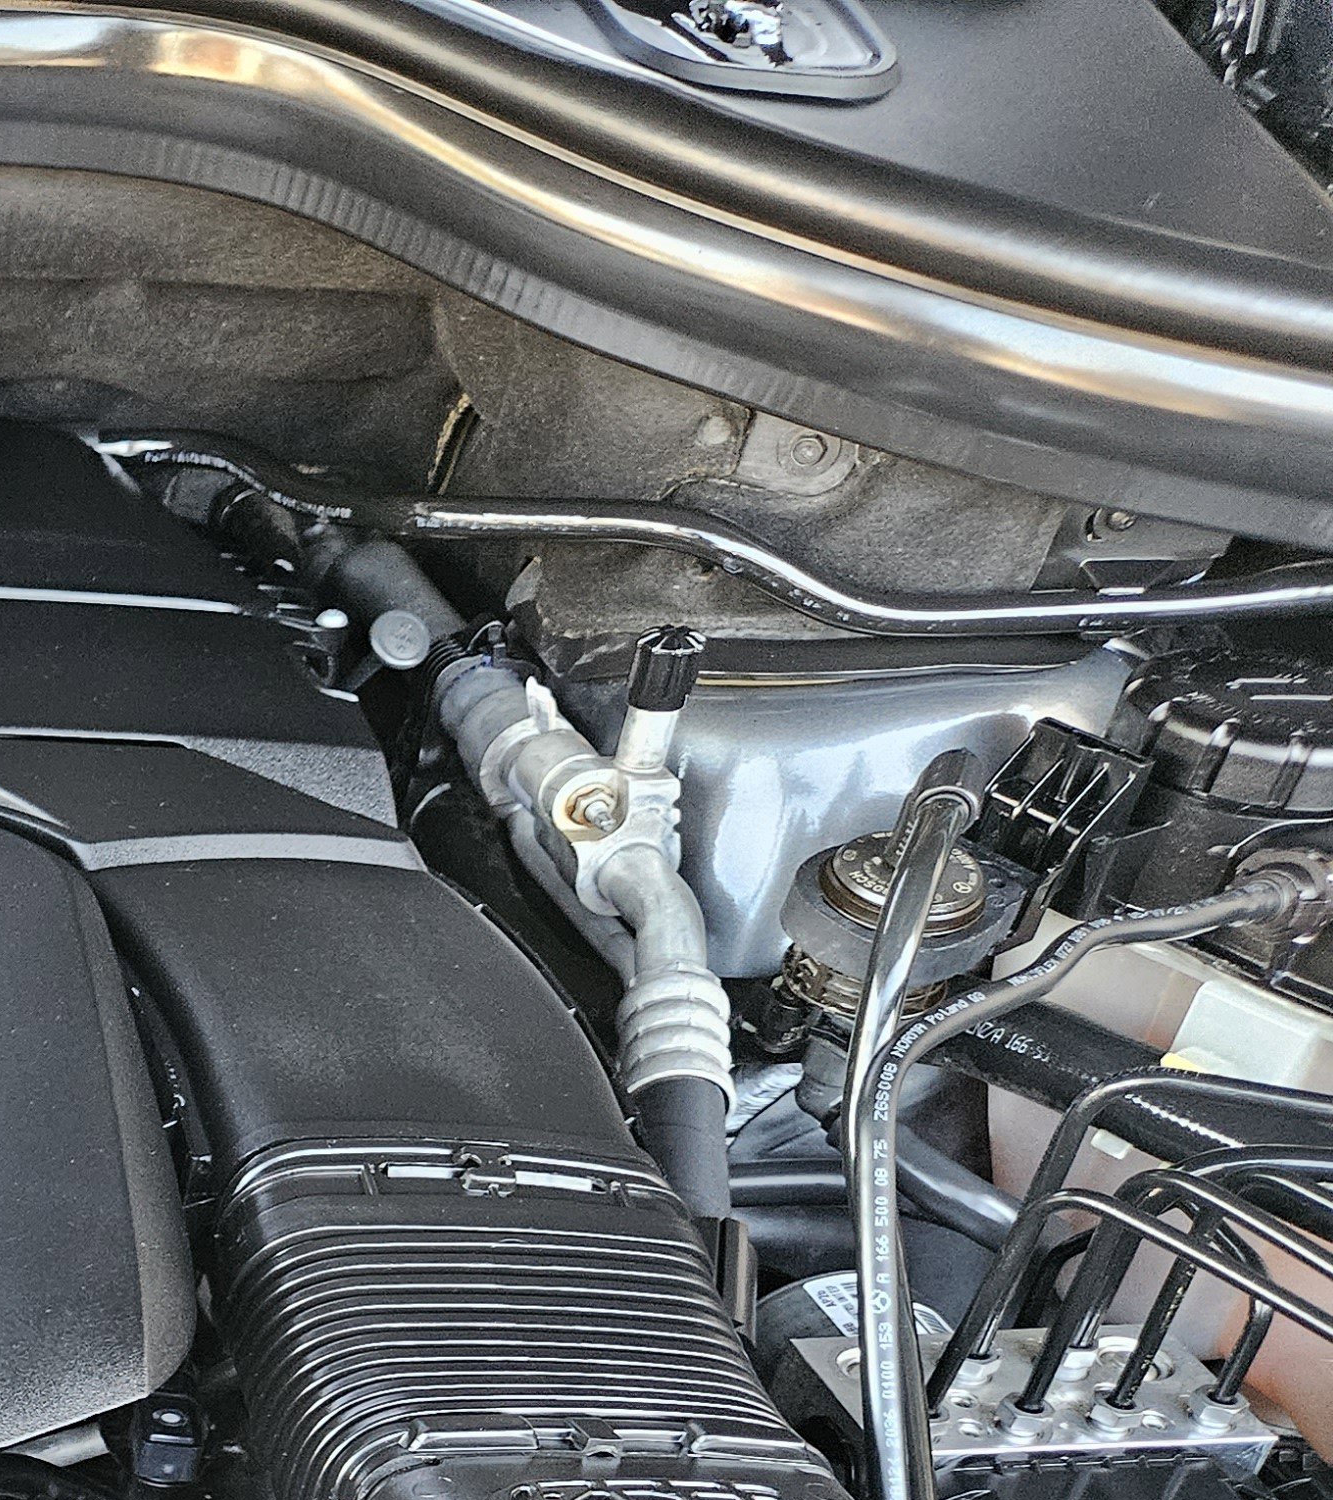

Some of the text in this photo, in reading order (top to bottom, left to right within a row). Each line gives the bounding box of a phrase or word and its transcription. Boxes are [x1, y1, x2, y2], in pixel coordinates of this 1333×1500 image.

[924, 998, 970, 1027] Poland
[873, 1139, 889, 1160] 75
[874, 1196, 889, 1227] 500
[876, 1234, 890, 1261] 166
